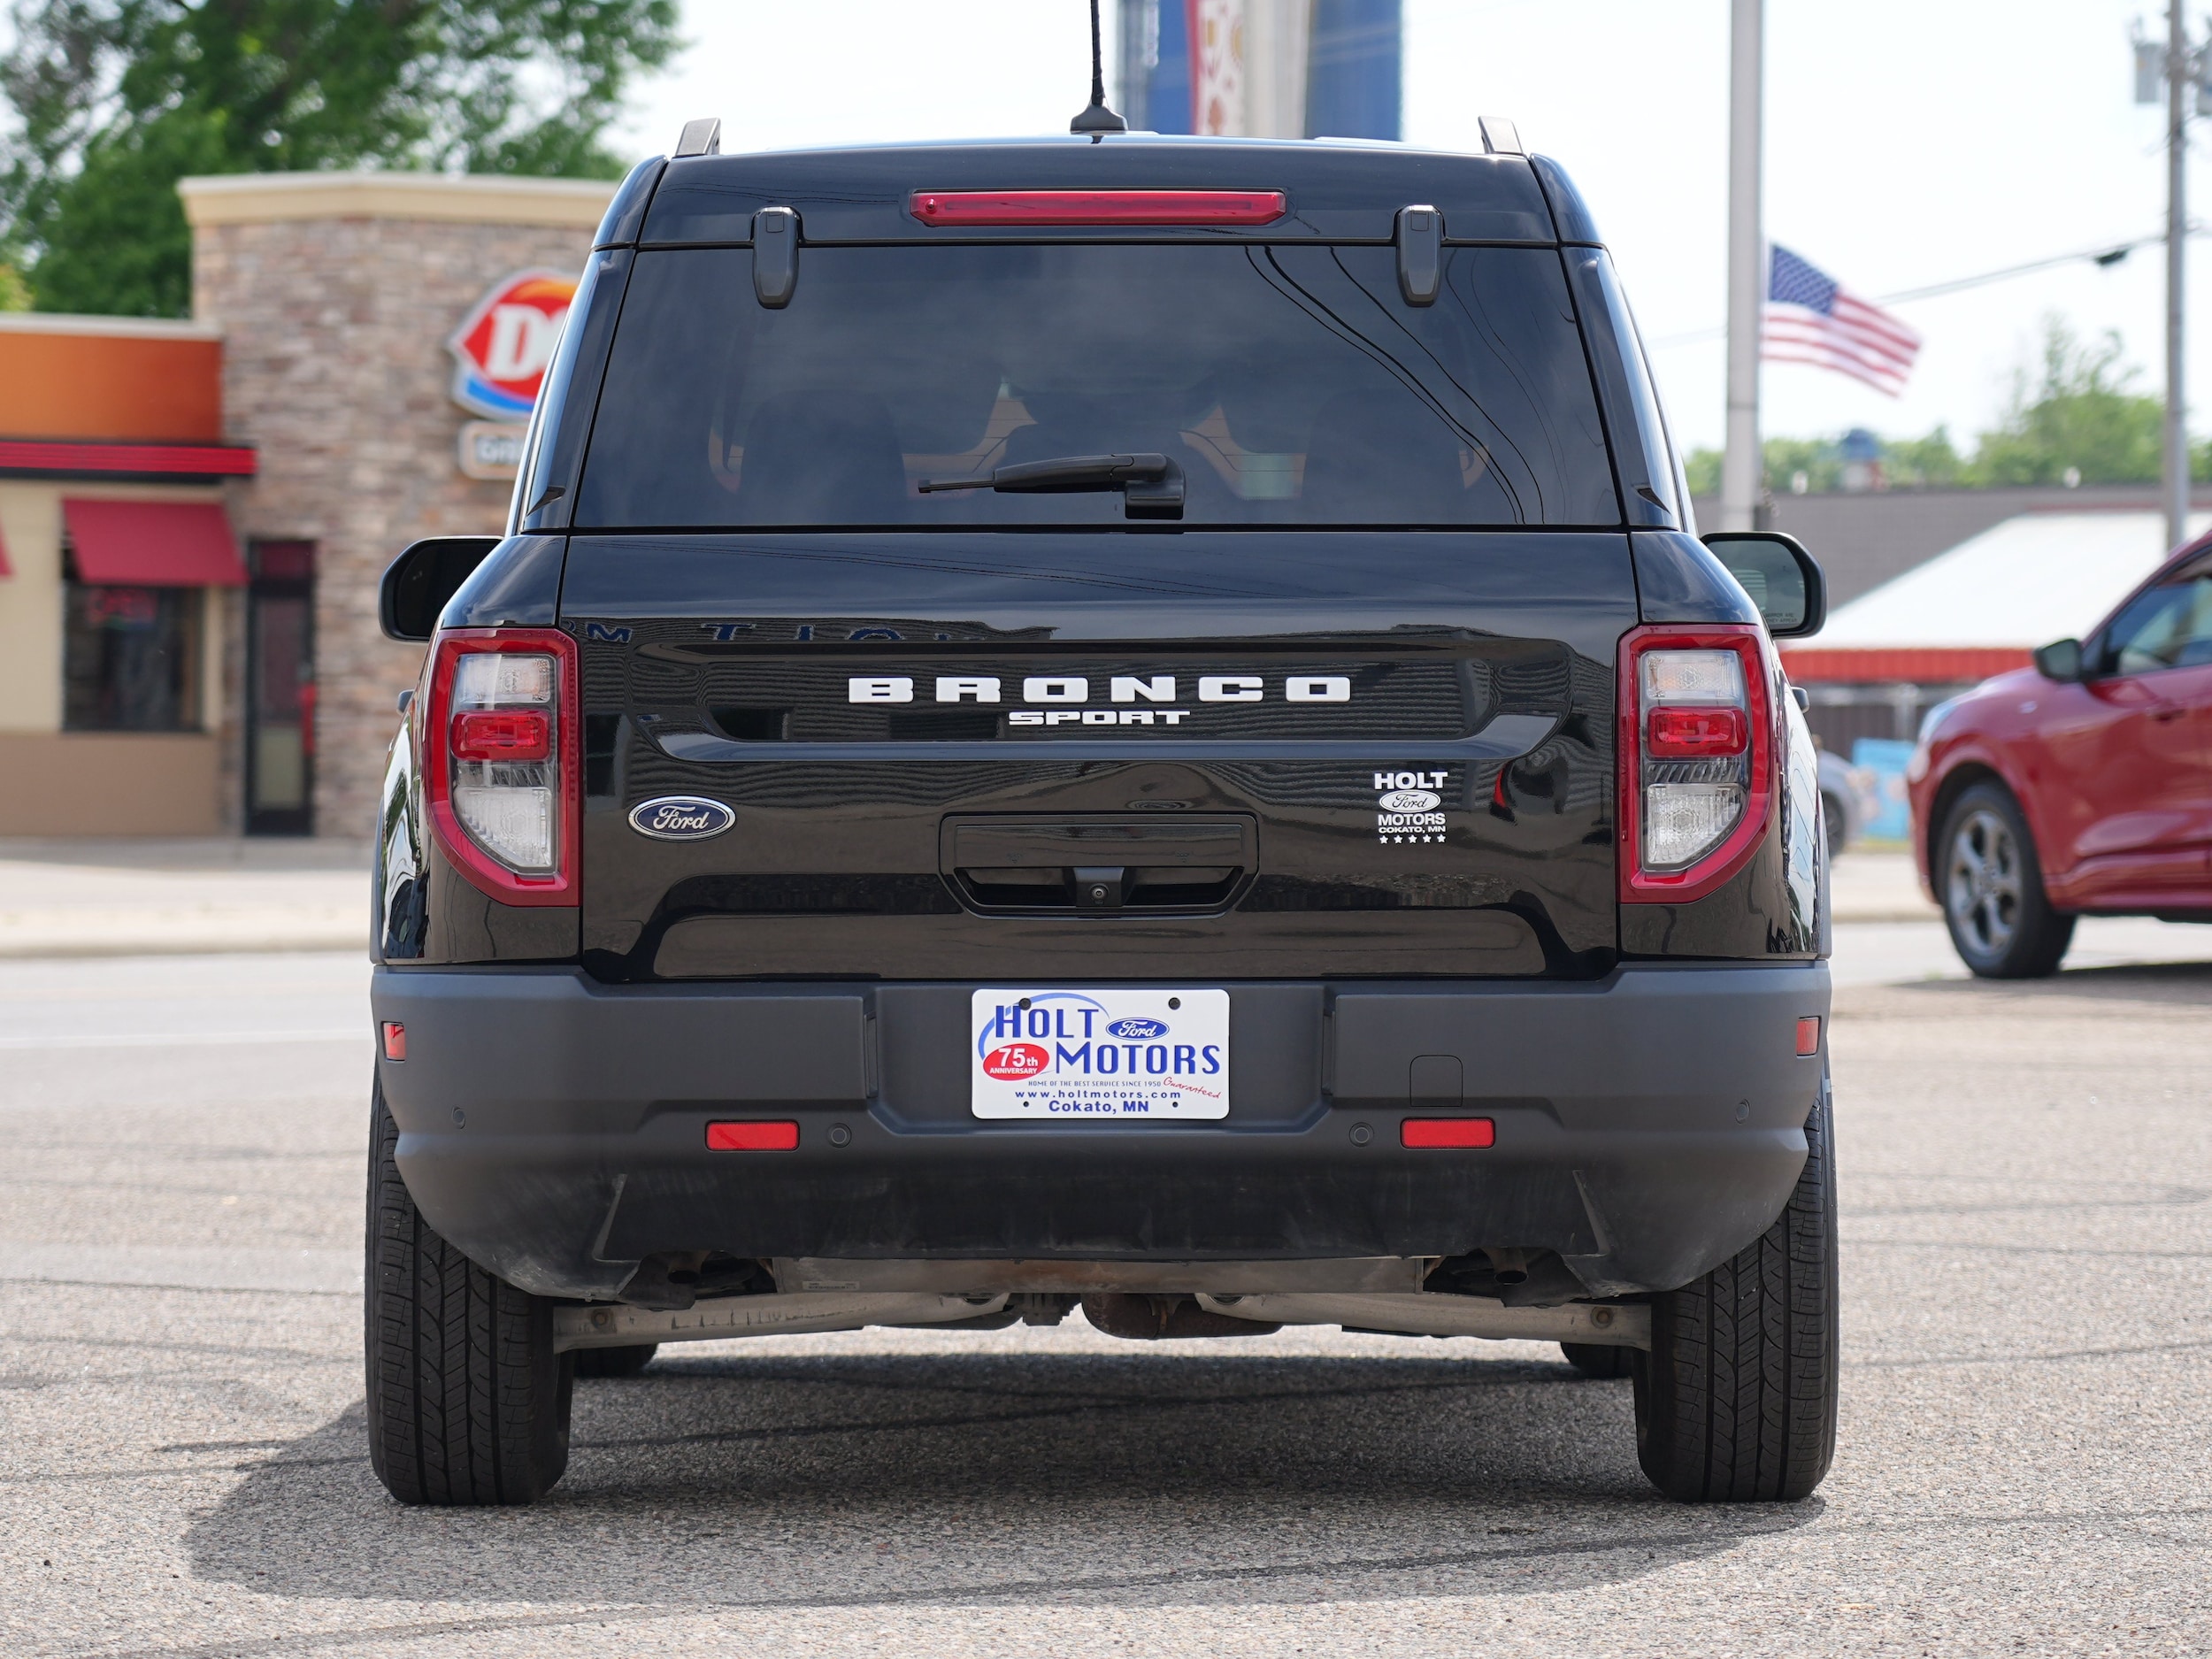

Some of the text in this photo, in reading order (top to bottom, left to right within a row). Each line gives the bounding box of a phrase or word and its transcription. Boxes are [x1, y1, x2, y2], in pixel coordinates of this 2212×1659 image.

[848, 676, 1351, 703] BRONCO
[1009, 710, 1191, 726] SPORT
[1374, 772, 1448, 789] HOLT
[1392, 794, 1428, 808] Ford
[653, 805, 710, 829] Ford
[1378, 813, 1447, 826] MOTORS
[995, 1004, 1099, 1038] HOLT
[1118, 1019, 1156, 1037] Ford
[998, 1048, 1039, 1067] 75th
[1056, 1041, 1221, 1074] MOTORS
[1015, 1089, 1181, 1099] www.holtmotors.com
[1163, 1076, 1221, 1099] Guaranteed
[1048, 1101, 1148, 1114] Cokato, MN
